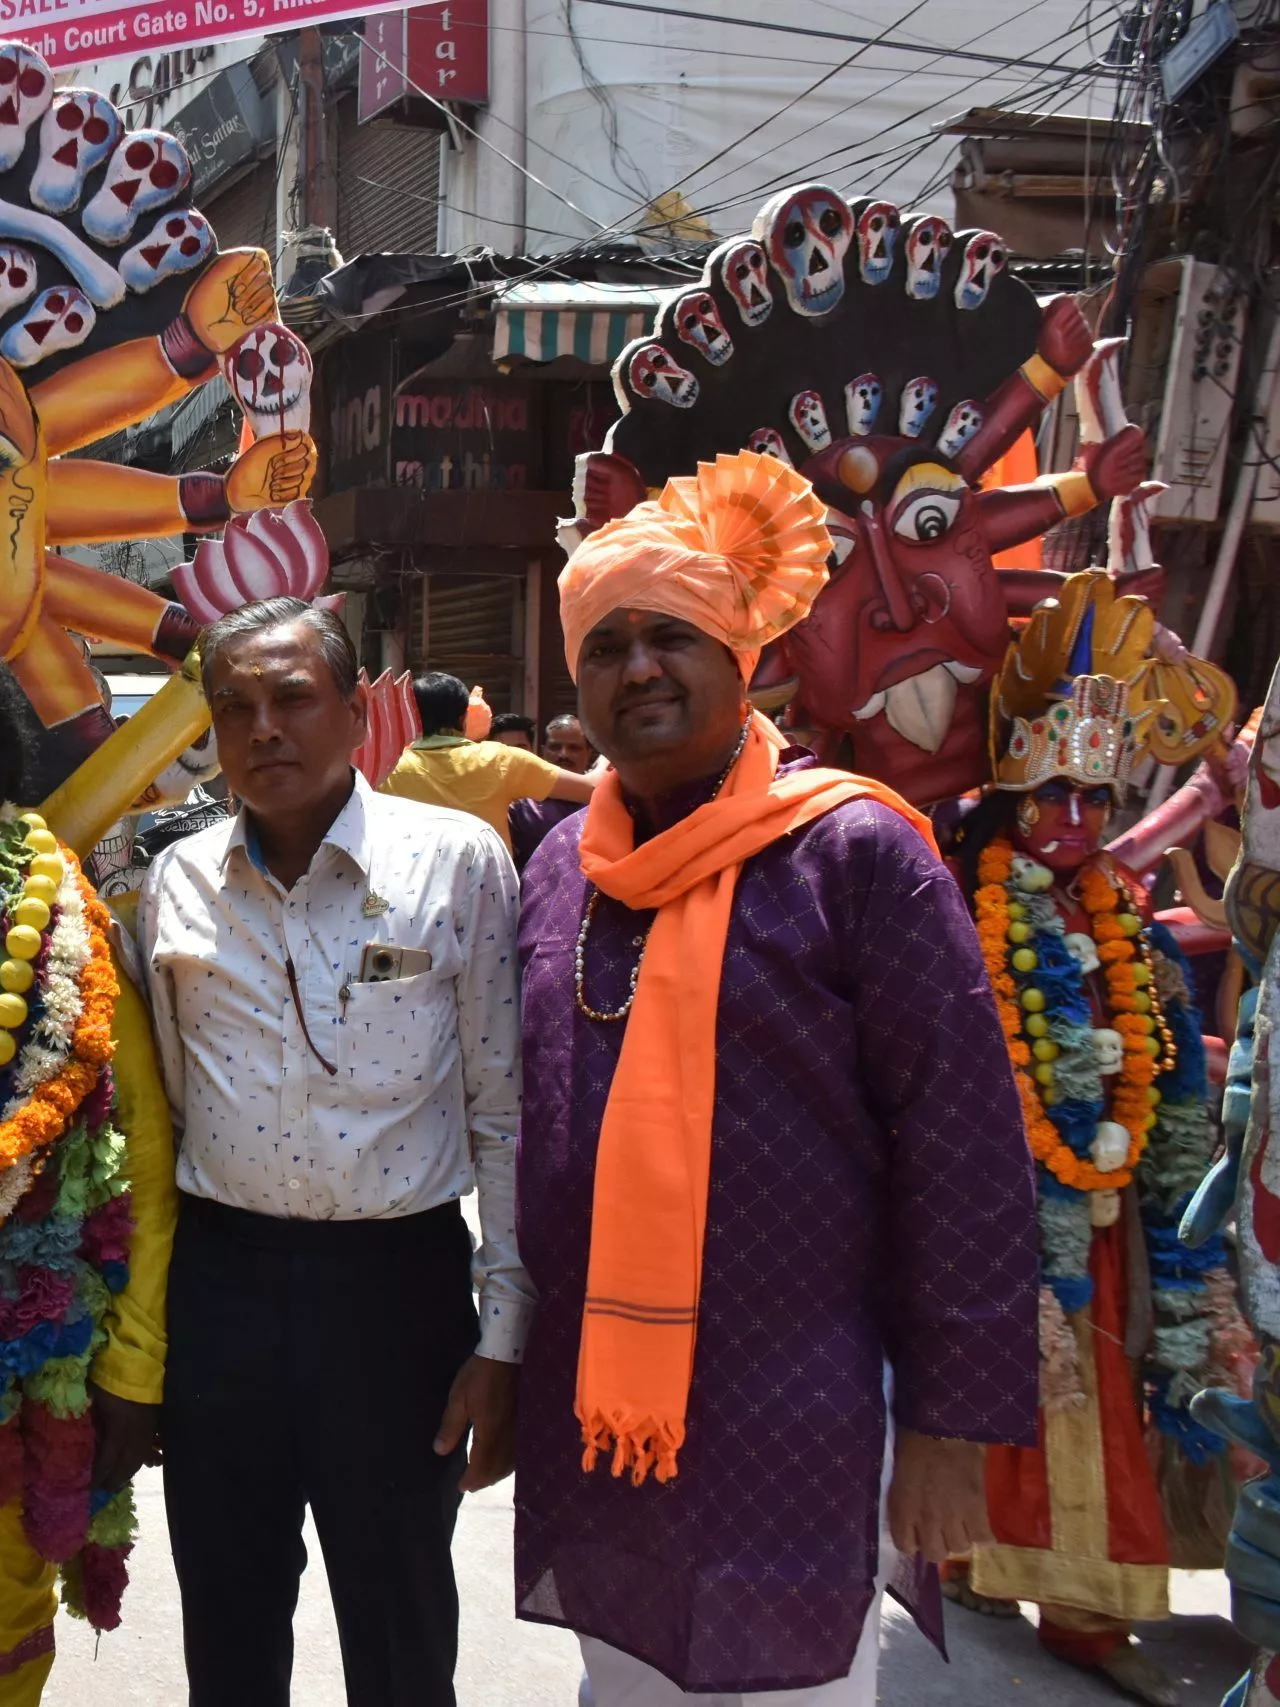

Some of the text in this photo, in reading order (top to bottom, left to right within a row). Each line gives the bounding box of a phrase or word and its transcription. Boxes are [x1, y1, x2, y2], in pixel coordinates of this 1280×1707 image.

[64, 16, 127, 51] Court
[133, 11, 187, 38] Gate
[195, 1, 235, 27] No.
